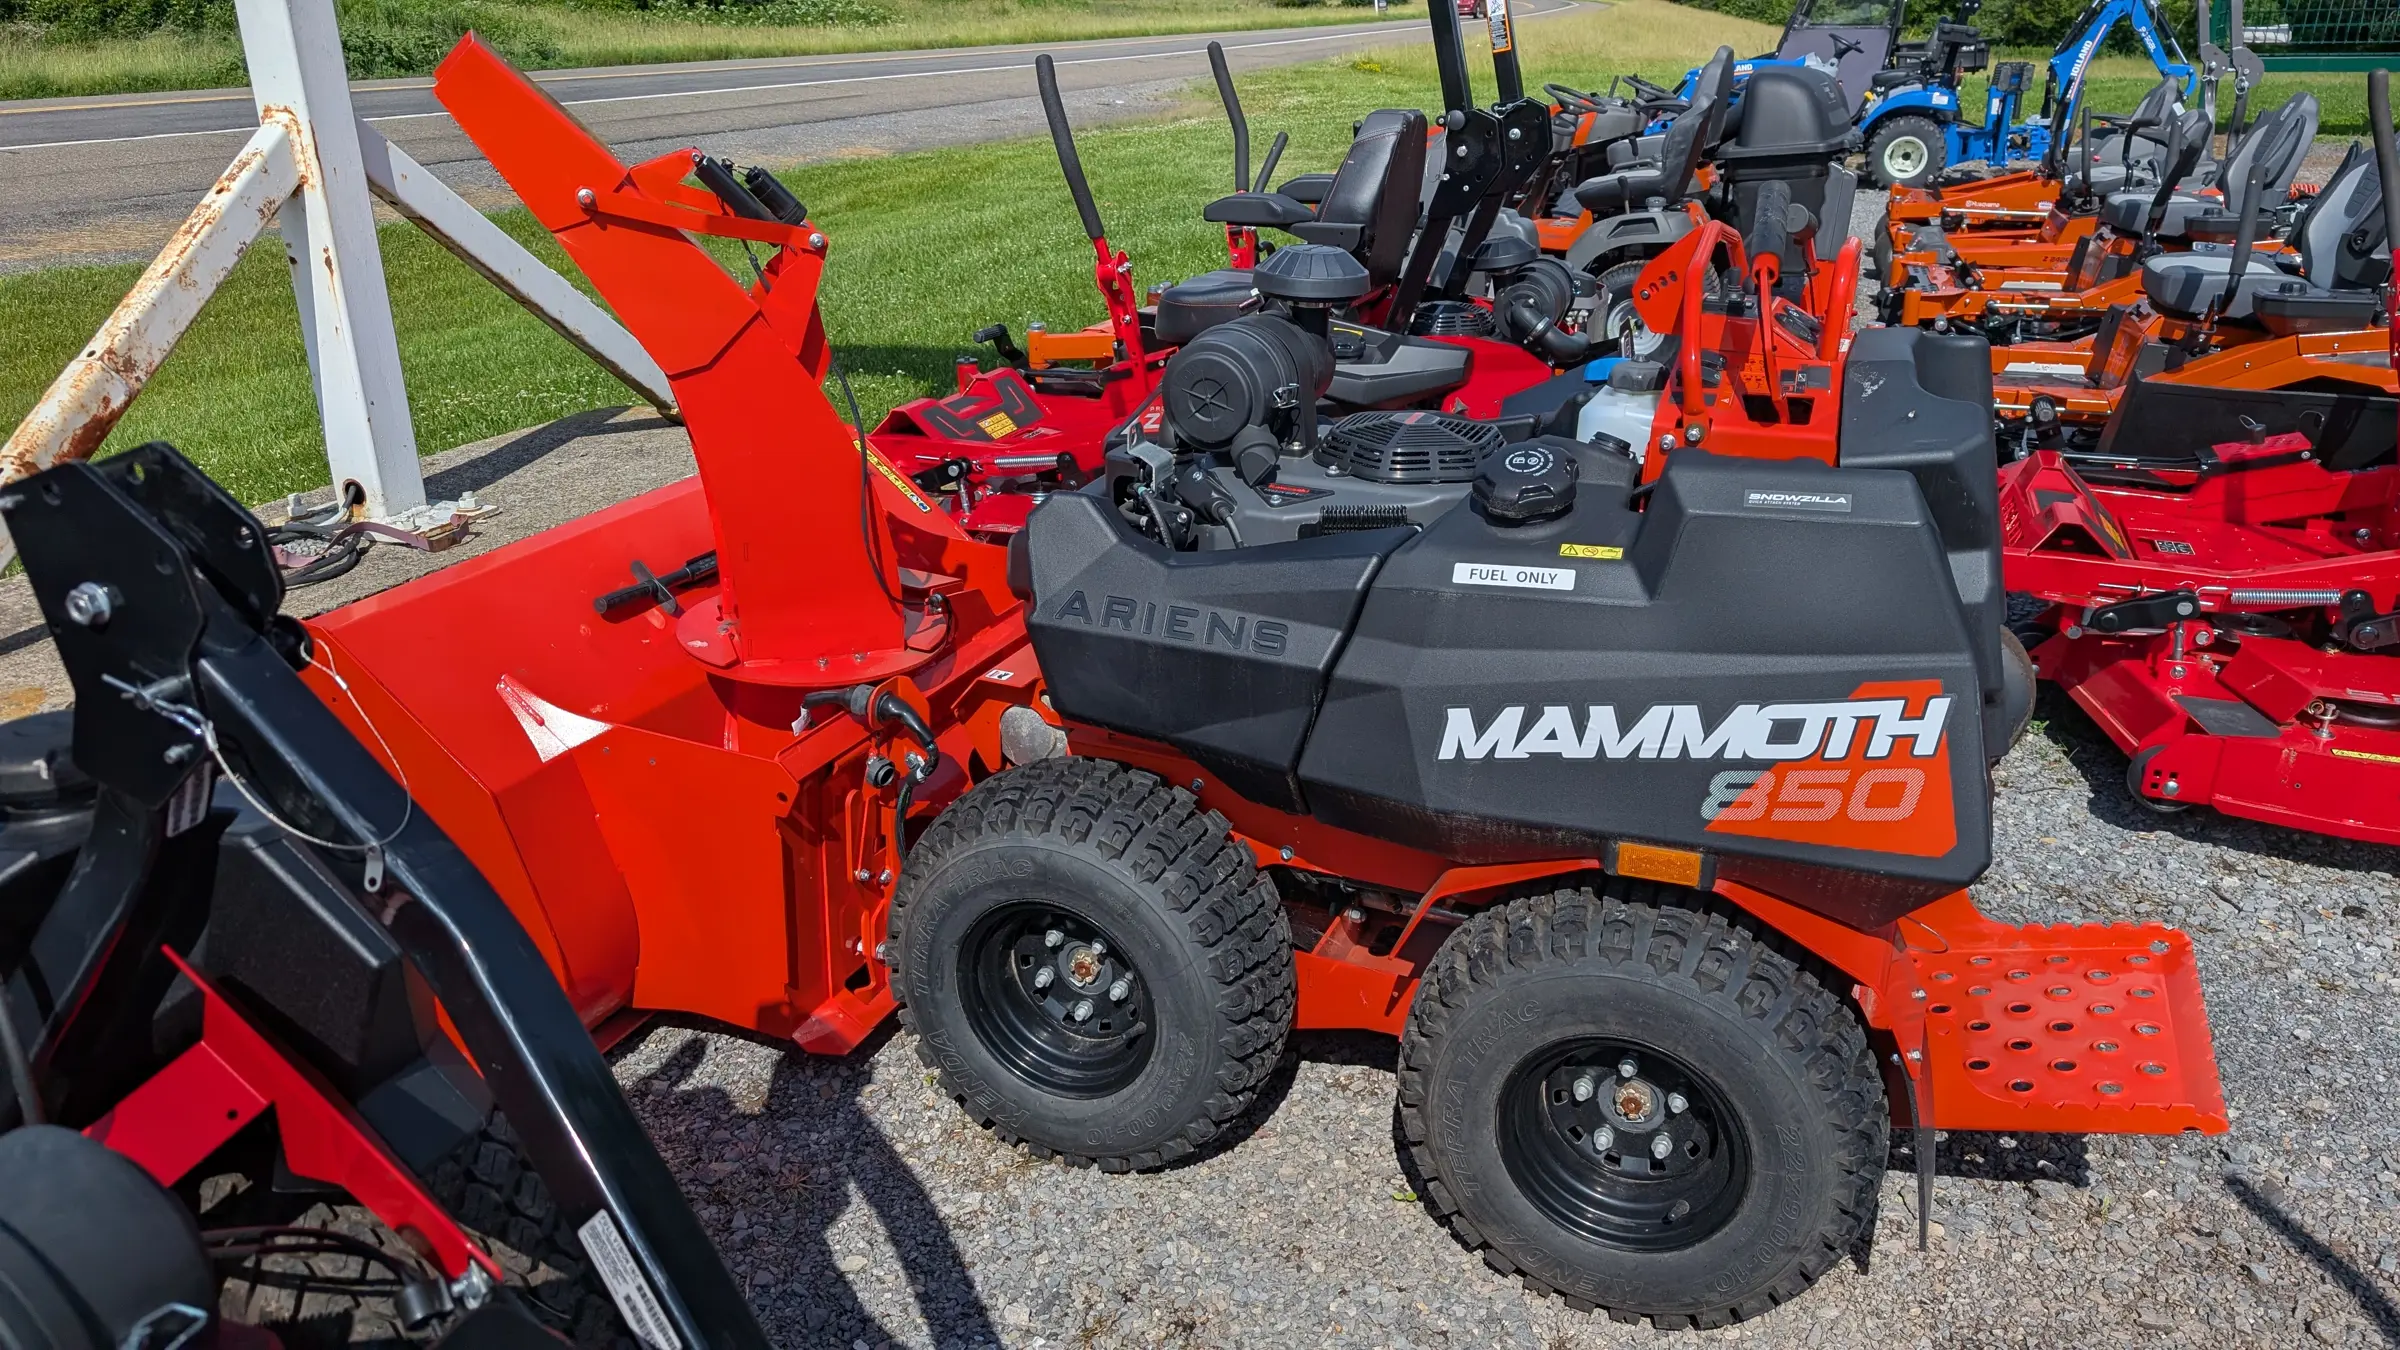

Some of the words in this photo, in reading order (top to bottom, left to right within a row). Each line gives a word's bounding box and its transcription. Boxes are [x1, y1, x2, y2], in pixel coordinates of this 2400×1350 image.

[1748, 493, 1848, 504] SNOWZILLA
[1469, 568, 1508, 582] FUEL
[1516, 570, 1558, 585] ONLY
[1054, 589, 1289, 656] ARIENS
[1437, 696, 1952, 760] MAMMOTH
[1700, 768, 1926, 822] 850
[911, 895, 950, 997] TERRA
[948, 859, 1033, 896] TRAC
[1457, 999, 1541, 1068] TRAC
[926, 1028, 1032, 1128] KENDA
[1442, 1078, 1482, 1198] TERRA
[1495, 1223, 1645, 1305] KENDA
